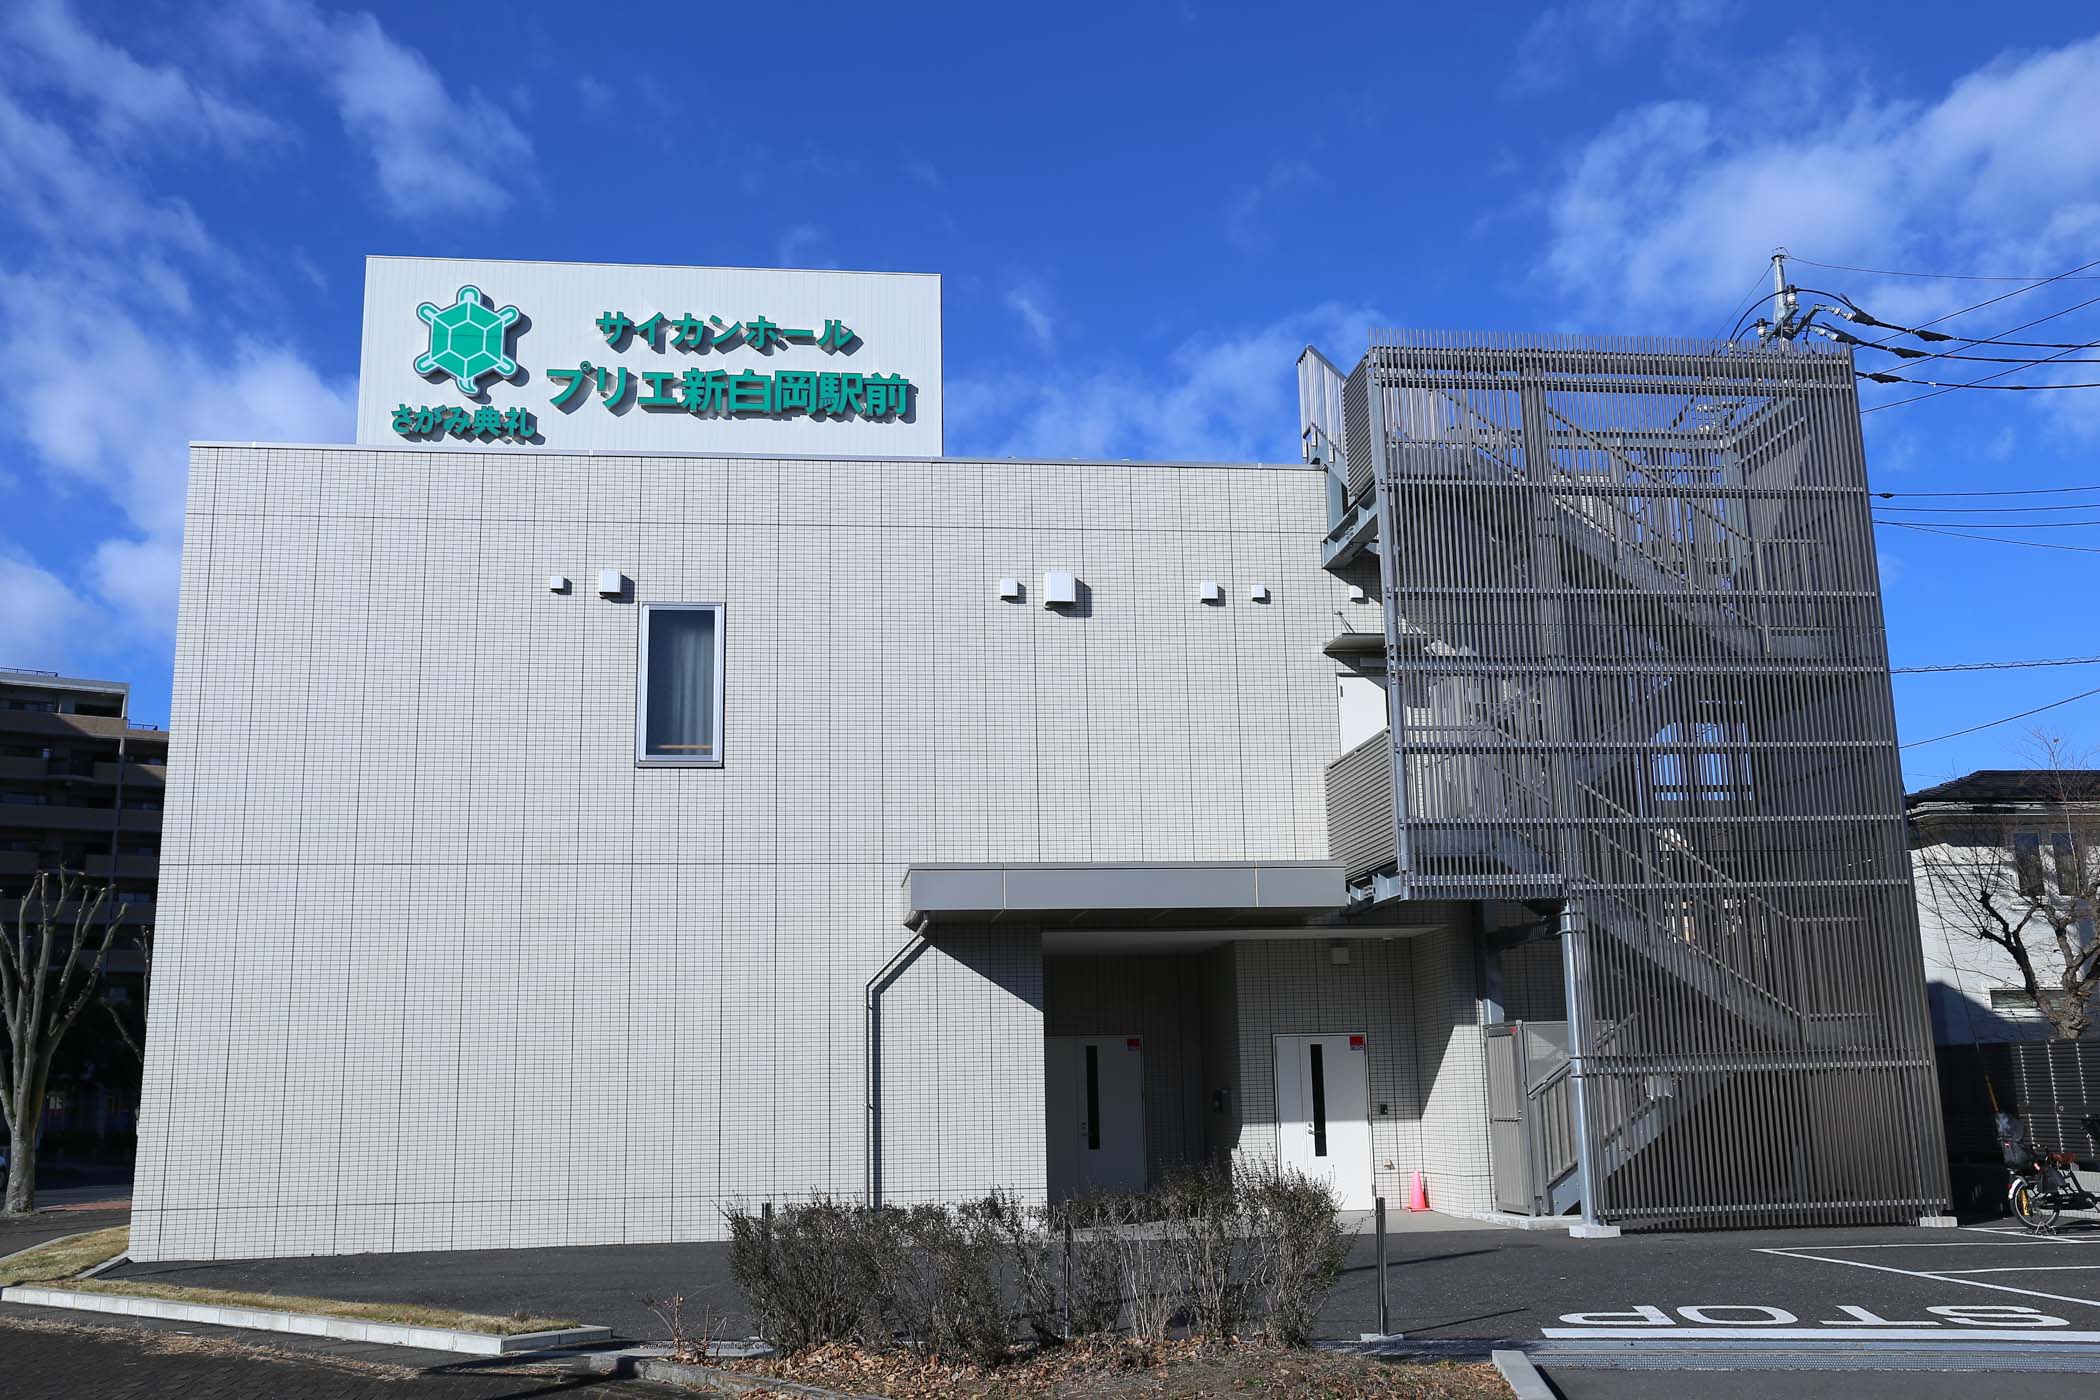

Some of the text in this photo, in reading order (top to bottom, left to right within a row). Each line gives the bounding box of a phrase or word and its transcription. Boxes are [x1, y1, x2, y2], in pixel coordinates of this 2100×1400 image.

[595, 311, 856, 348] サイカンホール
[546, 360, 911, 416] プリエ新白岡駅前
[391, 403, 535, 437] さがみ典礼
[1558, 1304, 2071, 1327] STOP
